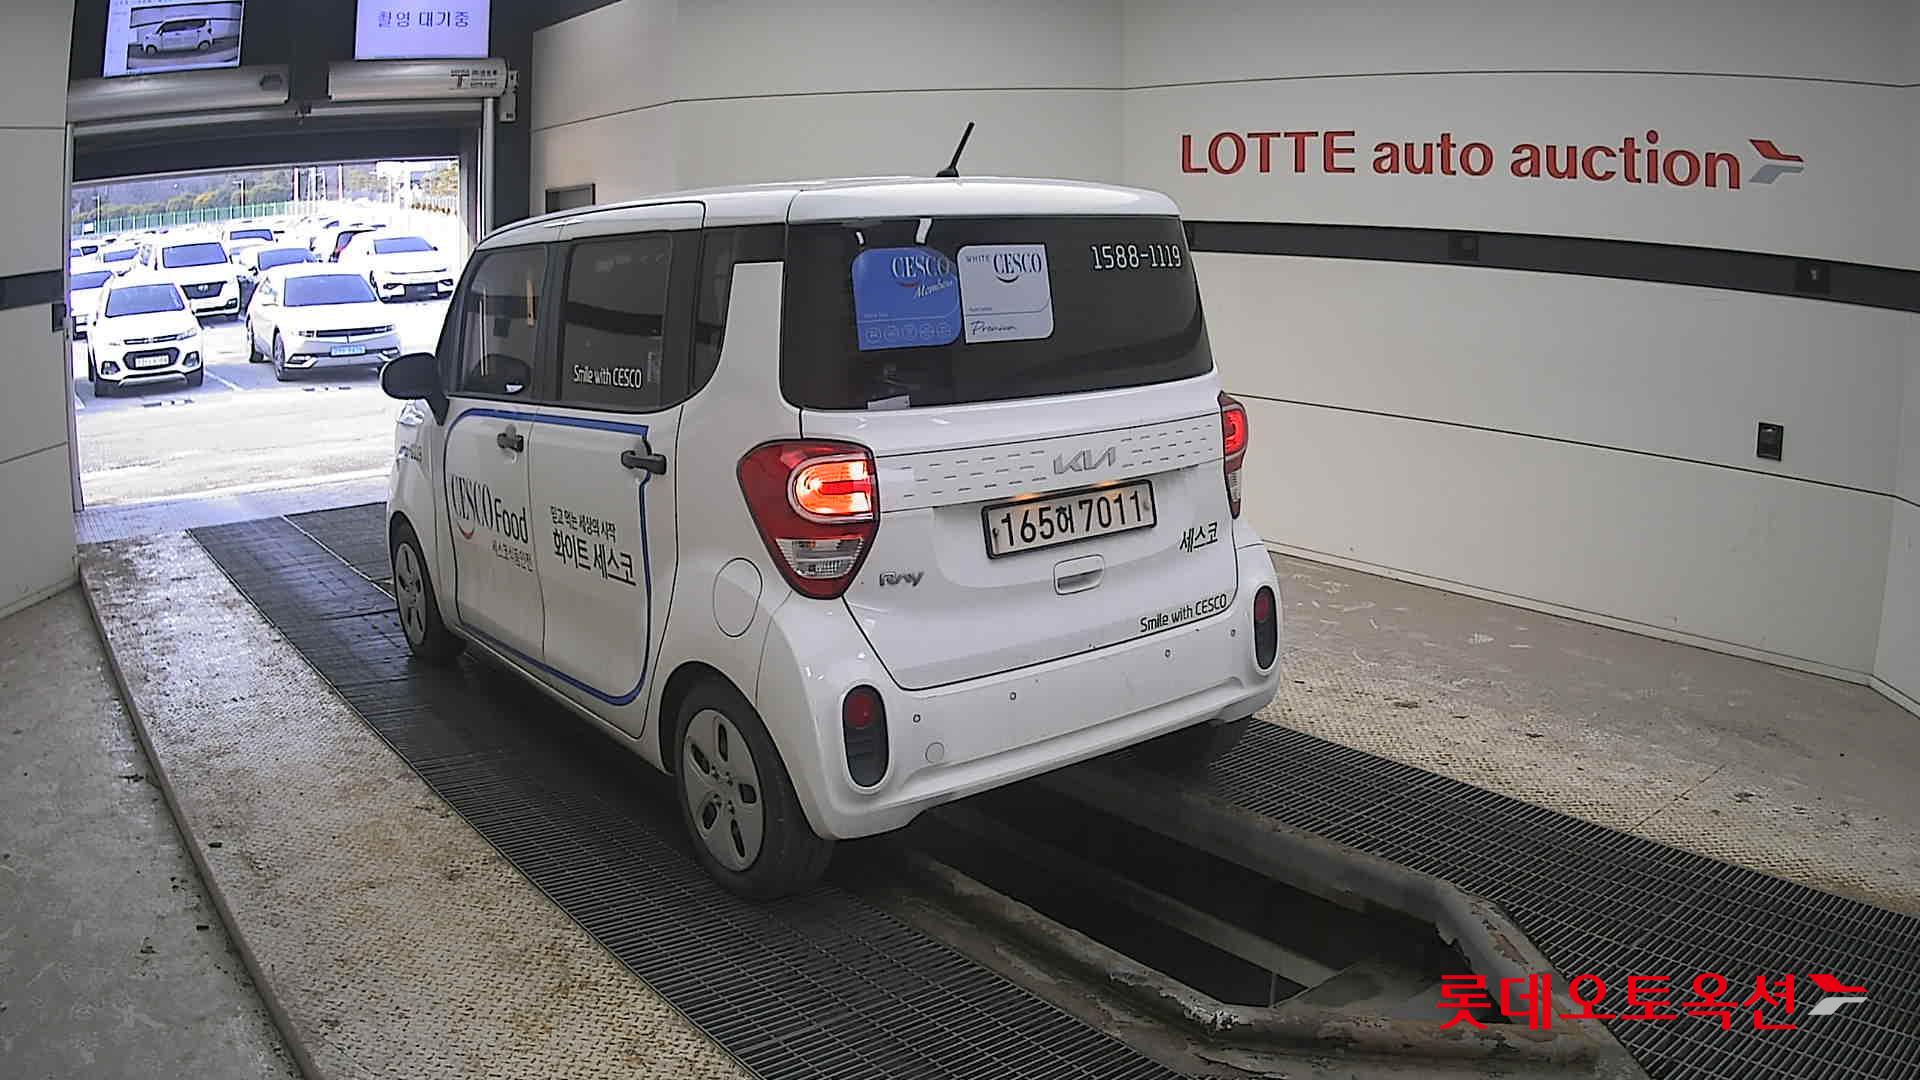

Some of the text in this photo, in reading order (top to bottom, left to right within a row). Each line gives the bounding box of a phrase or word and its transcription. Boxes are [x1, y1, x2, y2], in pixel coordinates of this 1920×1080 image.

[419, 11, 469, 28] 대기중
[1181, 129, 1742, 190] LOTTE auto auction
[892, 255, 950, 279] CESCO
[993, 252, 1042, 274] CESCO
[1091, 244, 1182, 270] 1588-1119
[573, 364, 642, 388] Smile with CESCO
[451, 475, 529, 544] CESCO Food
[1001, 490, 1142, 547] 165허 7011
[601, 520, 617, 544] 시작
[1179, 521, 1219, 553] 세스코
[552, 527, 637, 586] 화이트 세스코
[1140, 593, 1228, 633] Smile with CESCO
